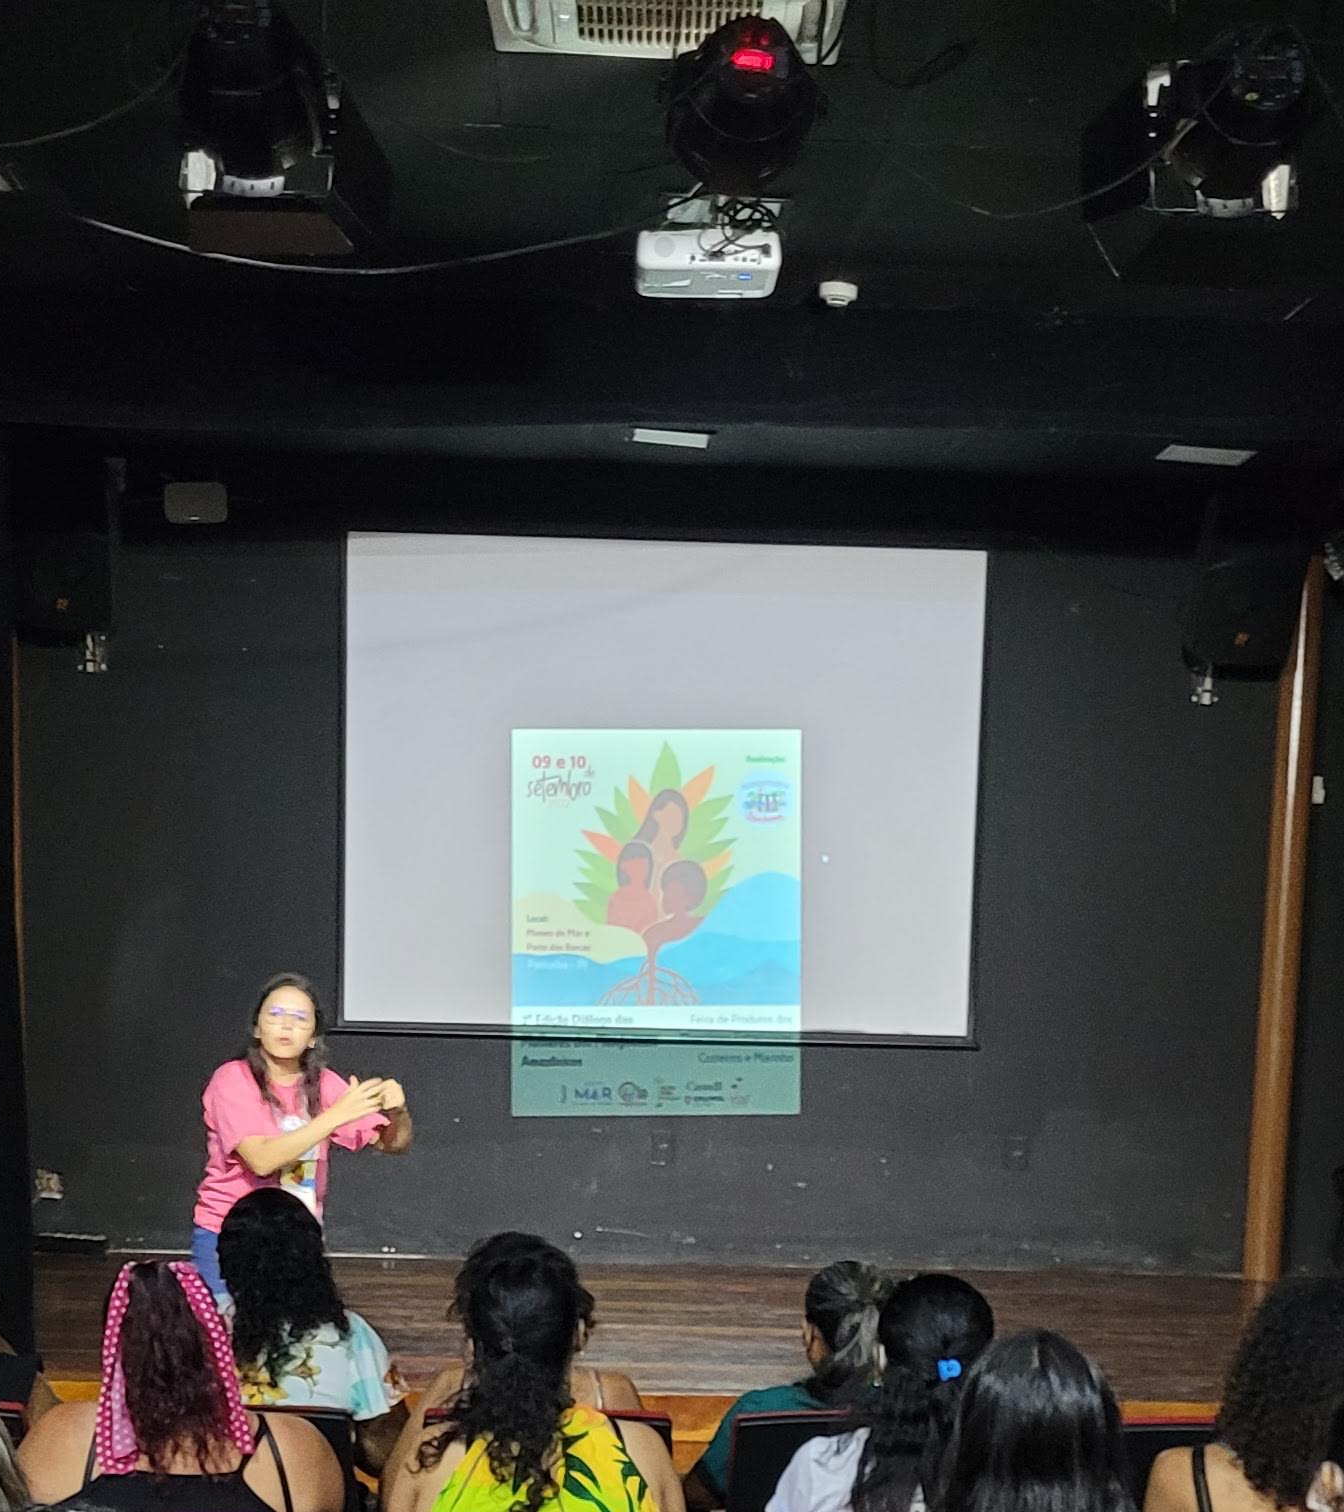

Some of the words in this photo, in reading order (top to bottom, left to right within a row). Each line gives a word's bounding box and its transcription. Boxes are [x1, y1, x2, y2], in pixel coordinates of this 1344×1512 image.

[532, 755, 551, 769] 09
[556, 758, 566, 769] e
[570, 755, 586, 769] 10
[526, 770, 592, 804] setembro
